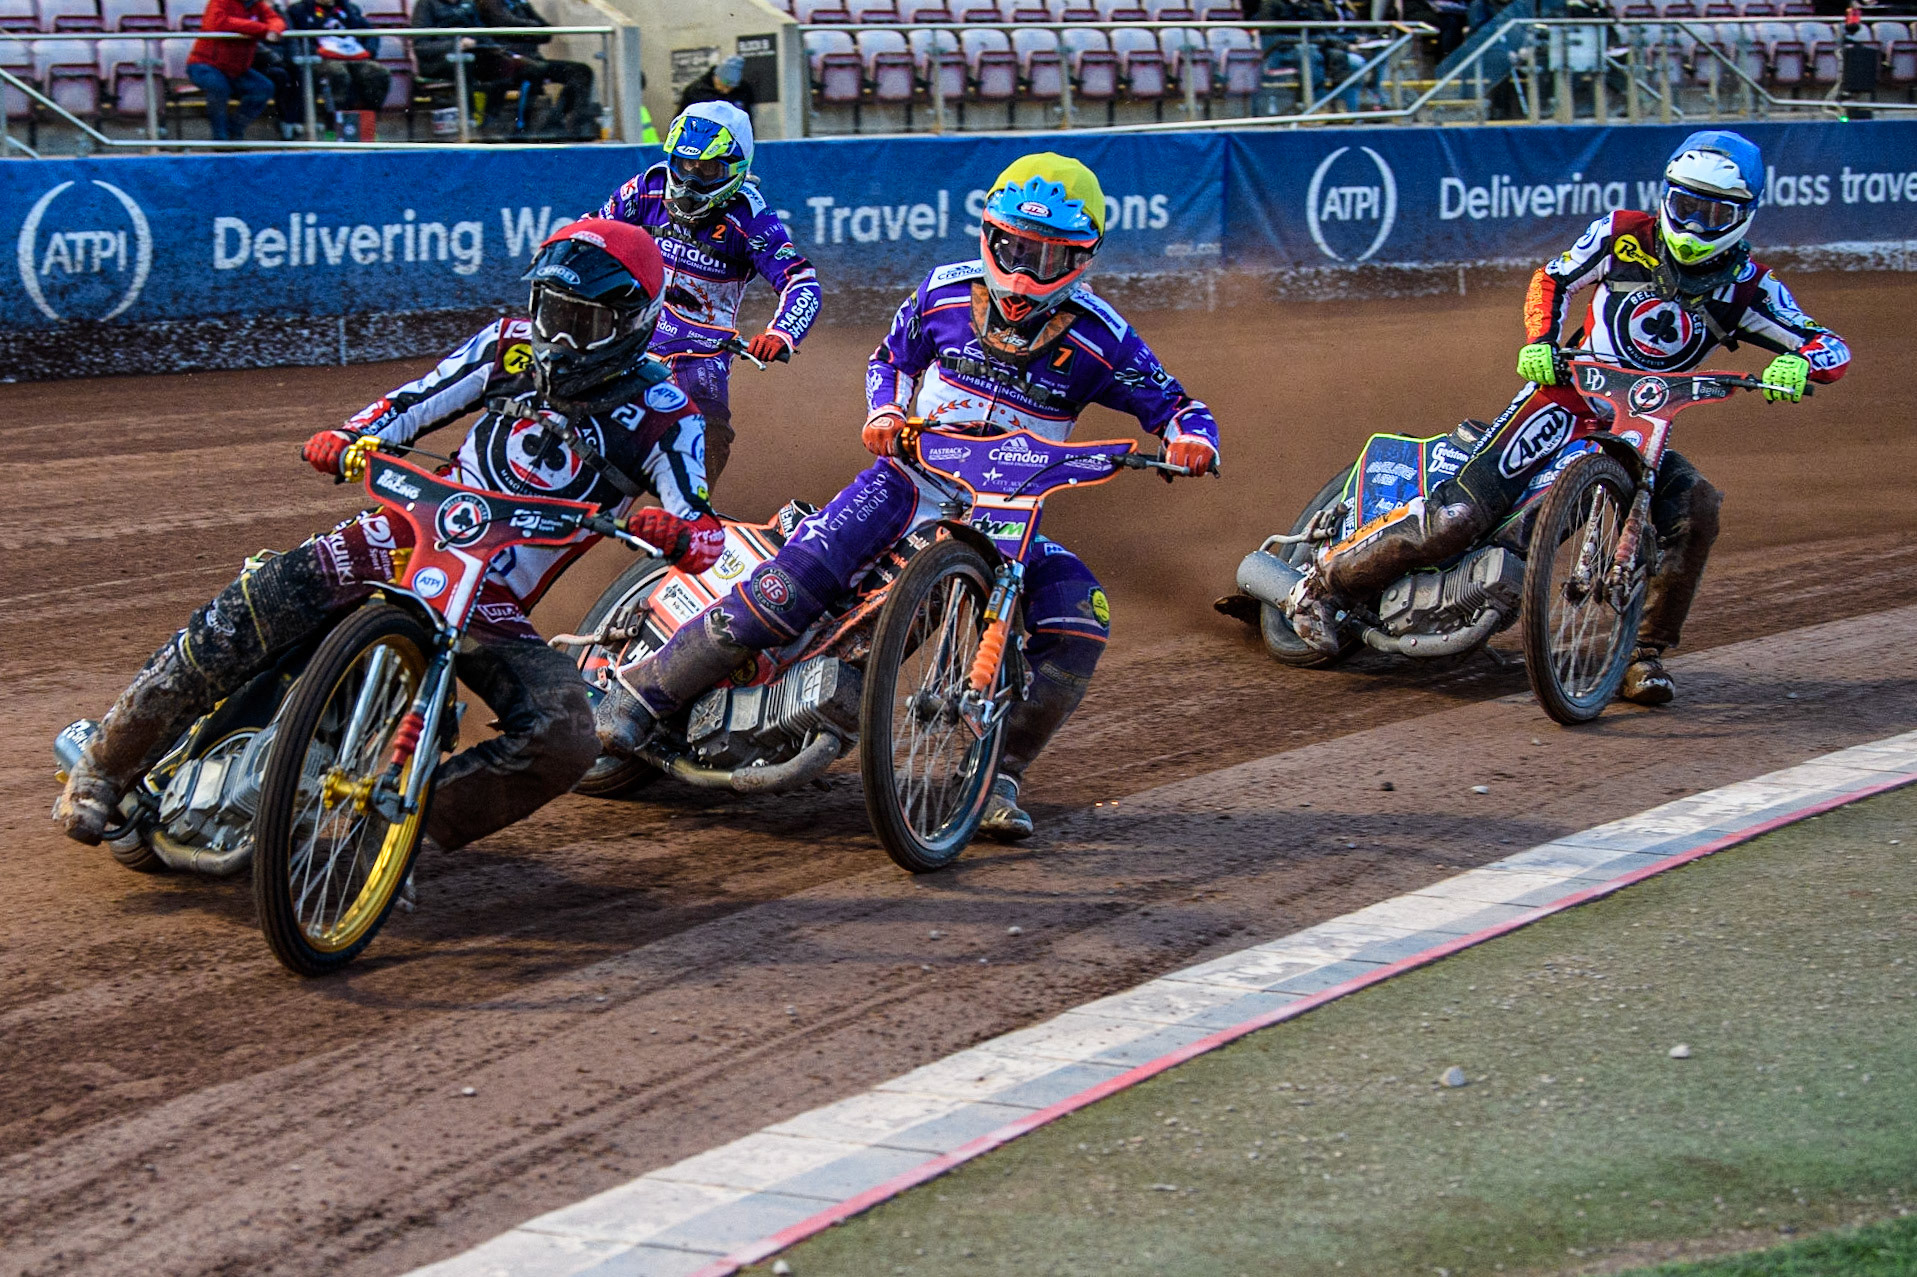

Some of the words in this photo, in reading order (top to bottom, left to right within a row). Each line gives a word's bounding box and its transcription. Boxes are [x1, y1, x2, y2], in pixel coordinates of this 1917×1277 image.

[1438, 172, 1628, 219] Delivering
[1758, 165, 1831, 207] lass
[1840, 166, 1917, 204] trave
[806, 189, 949, 244] Travel
[1320, 185, 1380, 222] ATPI
[213, 208, 484, 275] Delivering
[711, 224, 727, 240] 2
[41, 230, 127, 276] ATPI
[655, 236, 727, 269] rendon
[676, 256, 727, 275] NGINEERING
[937, 265, 984, 281] Crendo
[777, 287, 815, 330] HAGON
[787, 296, 820, 340] SHOCKS
[1053, 346, 1074, 367] 7
[653, 386, 679, 403] ATPI
[957, 372, 992, 390] TIMBER
[1519, 408, 1564, 466] Arai
[988, 448, 1049, 464] Crendon
[829, 505, 854, 531] CITY
[856, 488, 889, 522] GROUP
[1343, 496, 1355, 538] BONIFA
[419, 576, 442, 588] ATPI
[762, 578, 783, 600] STS
